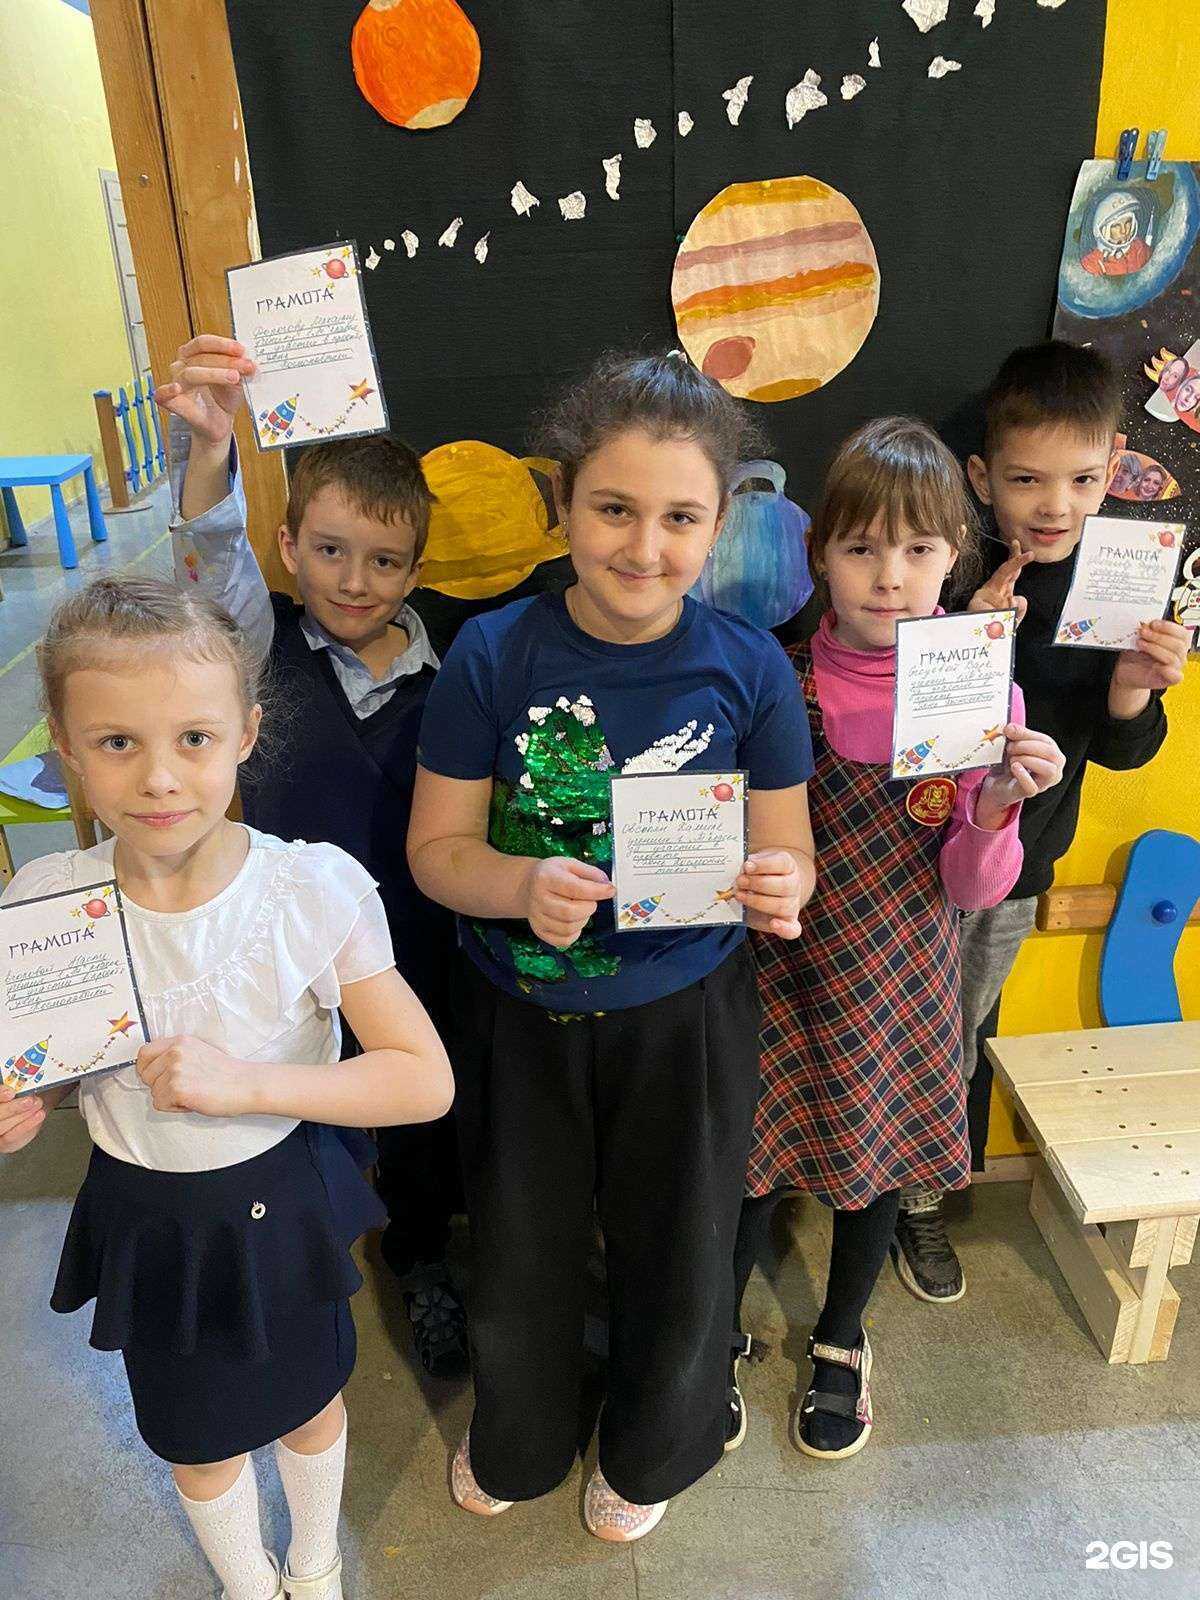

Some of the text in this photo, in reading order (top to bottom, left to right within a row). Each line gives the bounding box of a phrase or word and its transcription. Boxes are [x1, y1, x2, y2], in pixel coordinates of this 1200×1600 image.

[257, 287, 334, 314] ГРАМОТА
[1100, 546, 1159, 561] ГРАМОТА
[920, 646, 988, 665] ГРАМОТА
[639, 808, 718, 823] ГРАМОТА
[9, 927, 95, 959] ГРАМОТА
